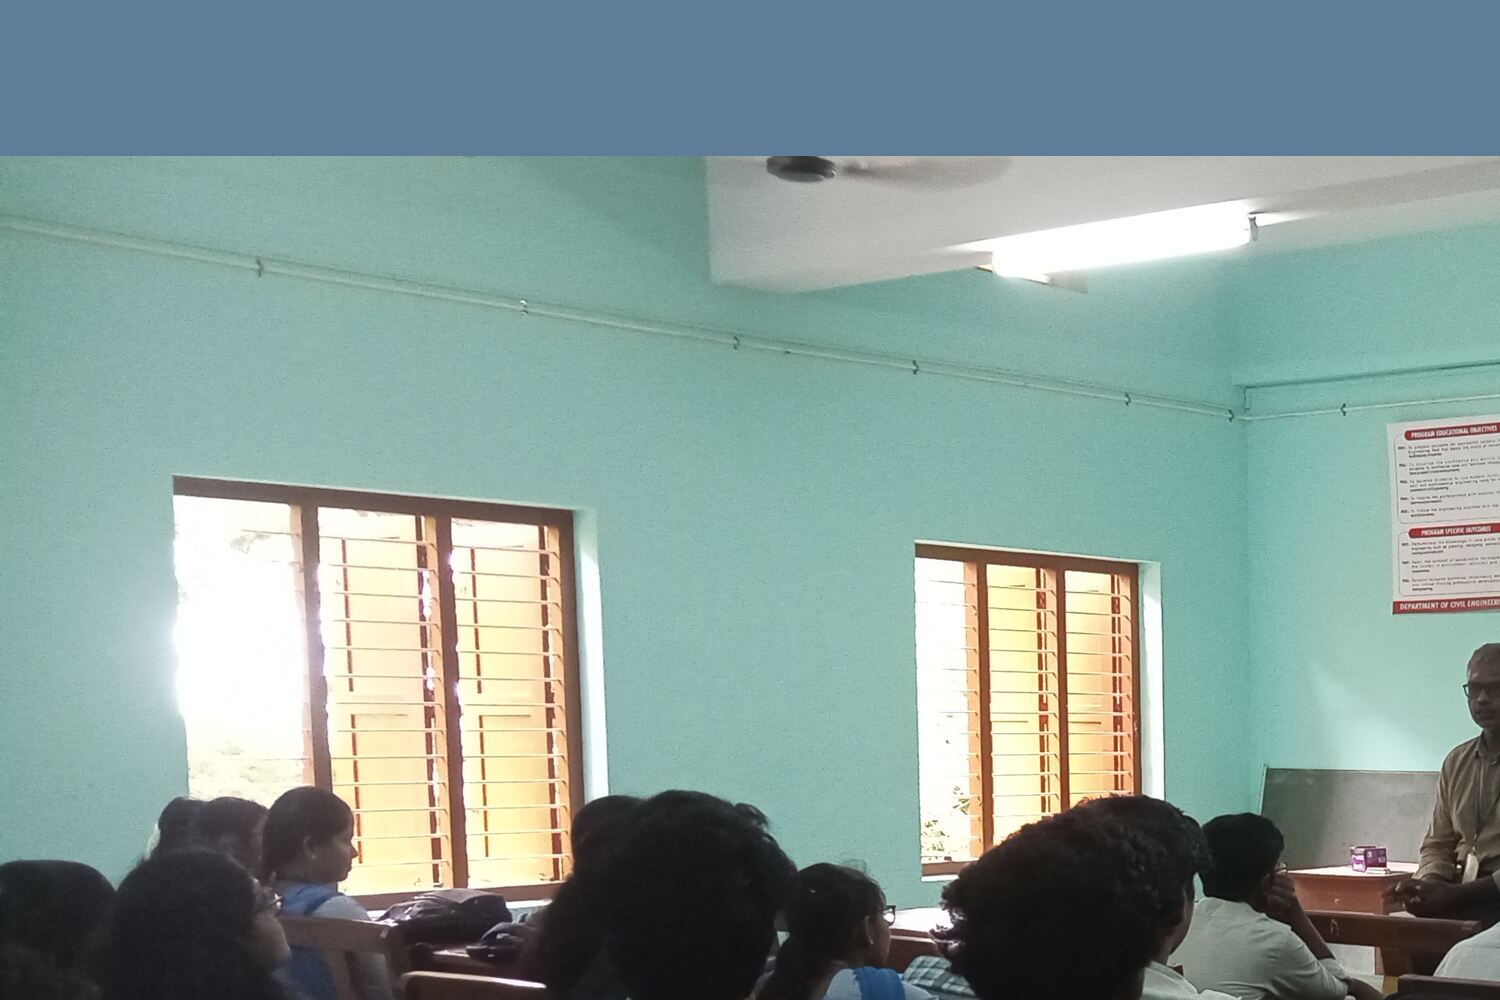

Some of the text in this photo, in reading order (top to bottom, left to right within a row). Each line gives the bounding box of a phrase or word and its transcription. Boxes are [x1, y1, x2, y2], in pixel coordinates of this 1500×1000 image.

[1436, 427, 1469, 437] EDUCATIONAL
[1470, 425, 1498, 434] OBJECTIVES
[1400, 602, 1439, 610] DEPARTMENT
[1450, 600, 1465, 608] CIVIL
